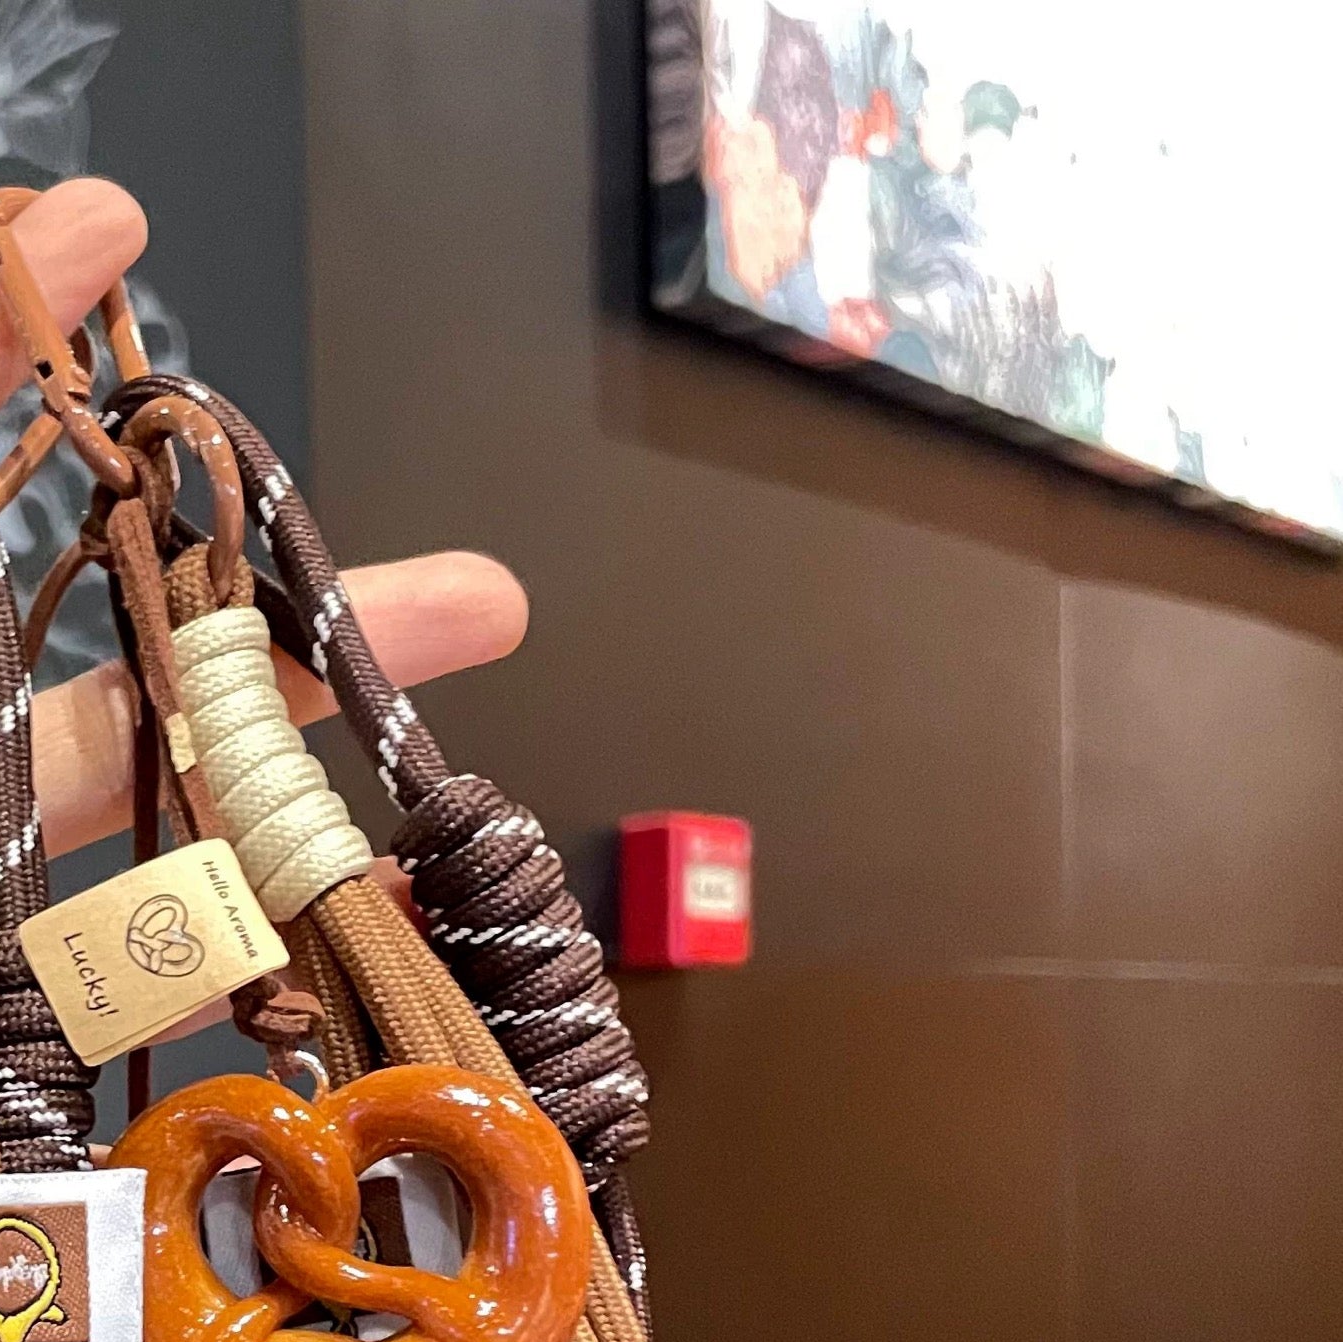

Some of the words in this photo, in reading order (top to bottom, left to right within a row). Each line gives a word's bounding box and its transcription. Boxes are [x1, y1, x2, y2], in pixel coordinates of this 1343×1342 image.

[202, 860, 229, 899] Hello
[223, 904, 259, 959] Aroma
[63, 931, 120, 1018] Lucky!
